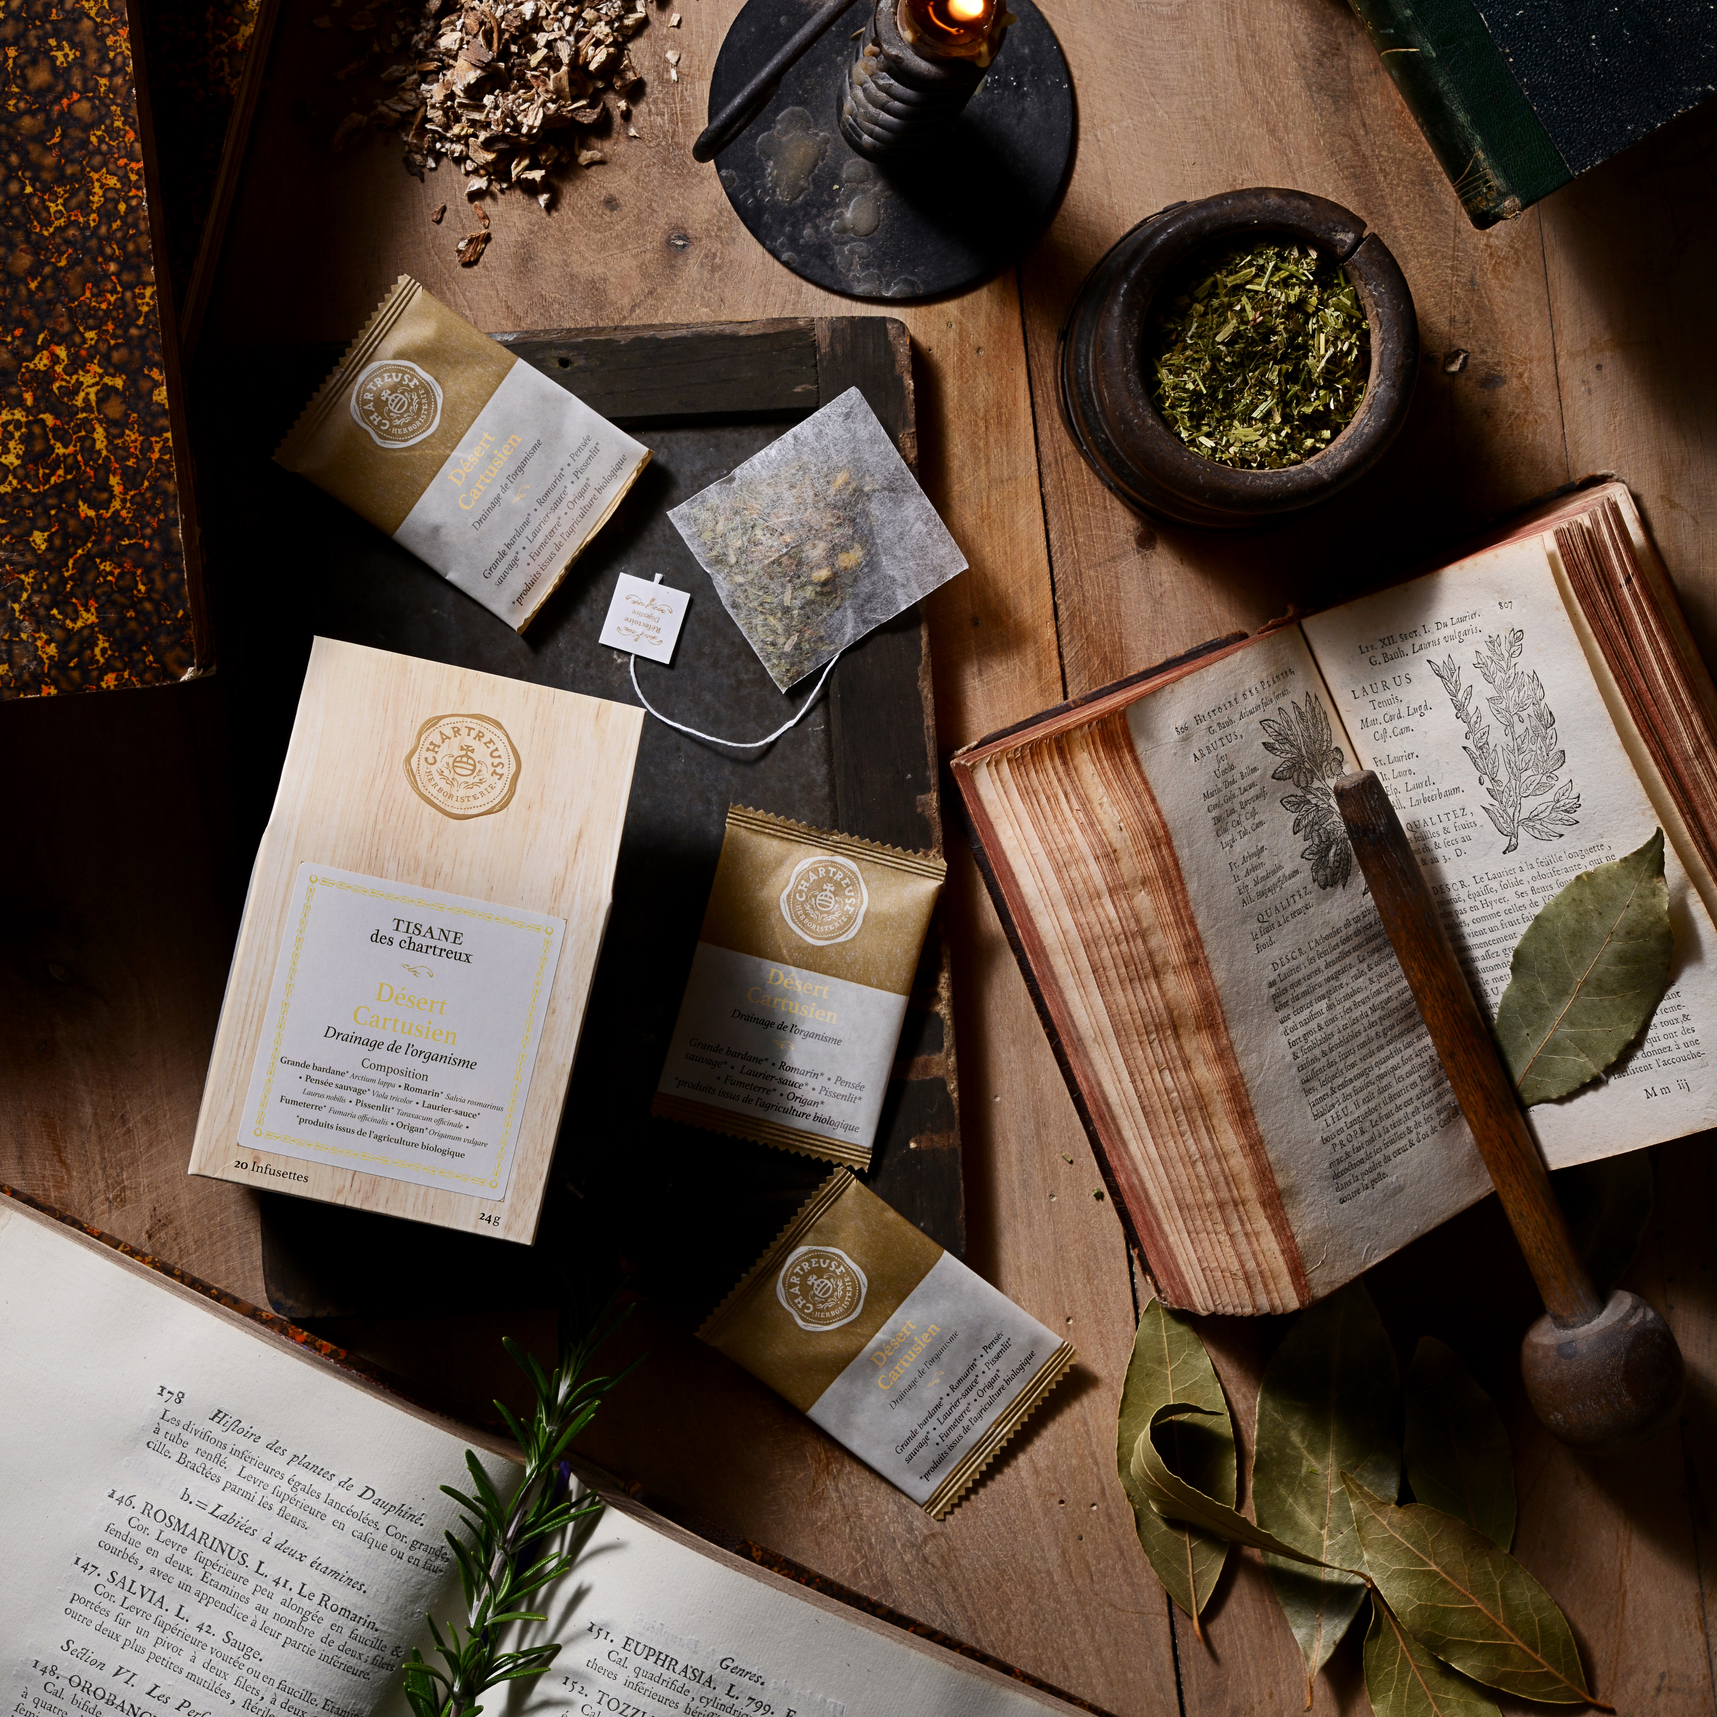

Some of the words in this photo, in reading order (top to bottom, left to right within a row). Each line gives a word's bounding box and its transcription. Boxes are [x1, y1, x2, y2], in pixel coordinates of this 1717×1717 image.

[363, 372, 419, 430] CHARTREUSE
[445, 431, 496, 488] Désert
[457, 433, 523, 511] Cartusien
[470, 492, 503, 532] Drainage
[499, 482, 511, 495] de
[481, 548, 509, 580] Grande
[568, 434, 593, 463] Pensée
[537, 550, 557, 573] issus
[552, 539, 565, 553] de
[593, 453, 629, 496] biologique
[623, 616, 663, 635] Réfectoire
[1497, 599, 1513, 611] 807
[1367, 654, 1382, 667] G.
[1380, 646, 1410, 664] Bauh.
[1411, 637, 1442, 656] Laurus
[1442, 623, 1483, 645] vulgaris.
[1421, 623, 1432, 635] I.
[1433, 620, 1449, 632] Du
[1350, 672, 1413, 701] LAURUS
[1367, 693, 1404, 711] Tenuis.
[1405, 698, 1434, 719] Lugd.
[1192, 694, 1241, 727] HISTOIRE
[424, 726, 505, 781] CHARTREUSE
[1192, 730, 1244, 764] ARBUTUS,
[796, 867, 855, 915] CHARTREUSE
[369, 928, 395, 947] des
[398, 935, 474, 965] chartreux
[391, 917, 464, 946] TISANE
[374, 980, 449, 1017] Désert
[765, 966, 831, 1000] Désert
[352, 1004, 458, 1047] Cartusien
[730, 1008, 777, 1031] Drainage
[775, 1020, 790, 1033] de
[747, 986, 839, 1026] Cartusien
[322, 1025, 386, 1053] Drainage
[385, 1039, 403, 1055] de
[1645, 1031, 1662, 1048] qui
[1662, 1030, 1679, 1041] ont
[1680, 1024, 1697, 1037] des
[279, 1055, 312, 1070] Grande
[348, 1072, 378, 1085] Arctium
[376, 1077, 397, 1090] lappa
[444, 1092, 467, 1105] Salvia
[465, 1098, 505, 1113] rosmarinus
[360, 1057, 430, 1083] Composition
[688, 1036, 725, 1055] Grande
[832, 1074, 867, 1093] Pensée
[301, 1087, 326, 1100] Laurus
[324, 1093, 347, 1104] nobilis
[395, 1107, 434, 1123] Taraxacum
[432, 1116, 464, 1130] officinale
[304, 1073, 335, 1089] Pensée
[371, 1089, 390, 1101] Viola
[388, 1094, 414, 1106] tricolor
[716, 1086, 742, 1103] issus
[740, 1093, 755, 1106] de
[811, 1111, 861, 1134] biologique
[327, 1105, 358, 1120] Fumaria
[356, 1113, 389, 1127] officinalis
[427, 1127, 463, 1143] Origanum
[462, 1137, 489, 1149] vulgare
[334, 1122, 356, 1135] issus
[355, 1127, 368, 1138] de
[419, 1140, 466, 1160] biologique
[233, 1159, 249, 1171] 20
[250, 1160, 310, 1184] Infusettes
[789, 1257, 846, 1314] CHARTREUSE
[868, 1319, 918, 1369] Désert
[877, 1323, 942, 1391] Cartusien
[888, 1376, 919, 1411] Drainage
[916, 1367, 927, 1380] de
[894, 1427, 920, 1456] Grande
[981, 1329, 1005, 1355] Pensée
[945, 1432, 965, 1453] issus
[961, 1423, 972, 1436] de
[1002, 1349, 1037, 1387] biologique
[156, 1384, 186, 1405] 178
[264, 1438, 288, 1457] des
[285, 1453, 337, 1482] plantes
[337, 1476, 355, 1492] de
[356, 1484, 427, 1528] Dauphiné.
[106, 1488, 138, 1510] 146.
[139, 1500, 250, 1569] ROSMARINUS.
[253, 1559, 269, 1579] L.
[296, 1581, 316, 1602] Le
[316, 1592, 380, 1633] Romarin.
[261, 1530, 275, 1546] à
[273, 1539, 308, 1563] deux
[308, 1555, 368, 1595] étamines.
[73, 1555, 102, 1578] 147.
[106, 1569, 170, 1613] SALVIA.
[173, 1603, 190, 1624] L.
[195, 1621, 216, 1638] 42.
[221, 1629, 264, 1663] Sauge.
[586, 1620, 615, 1644] 151.
[620, 1635, 717, 1691] EUPHRASIA.
[724, 1682, 740, 1701] L.
[718, 1656, 766, 1687] Genres.
